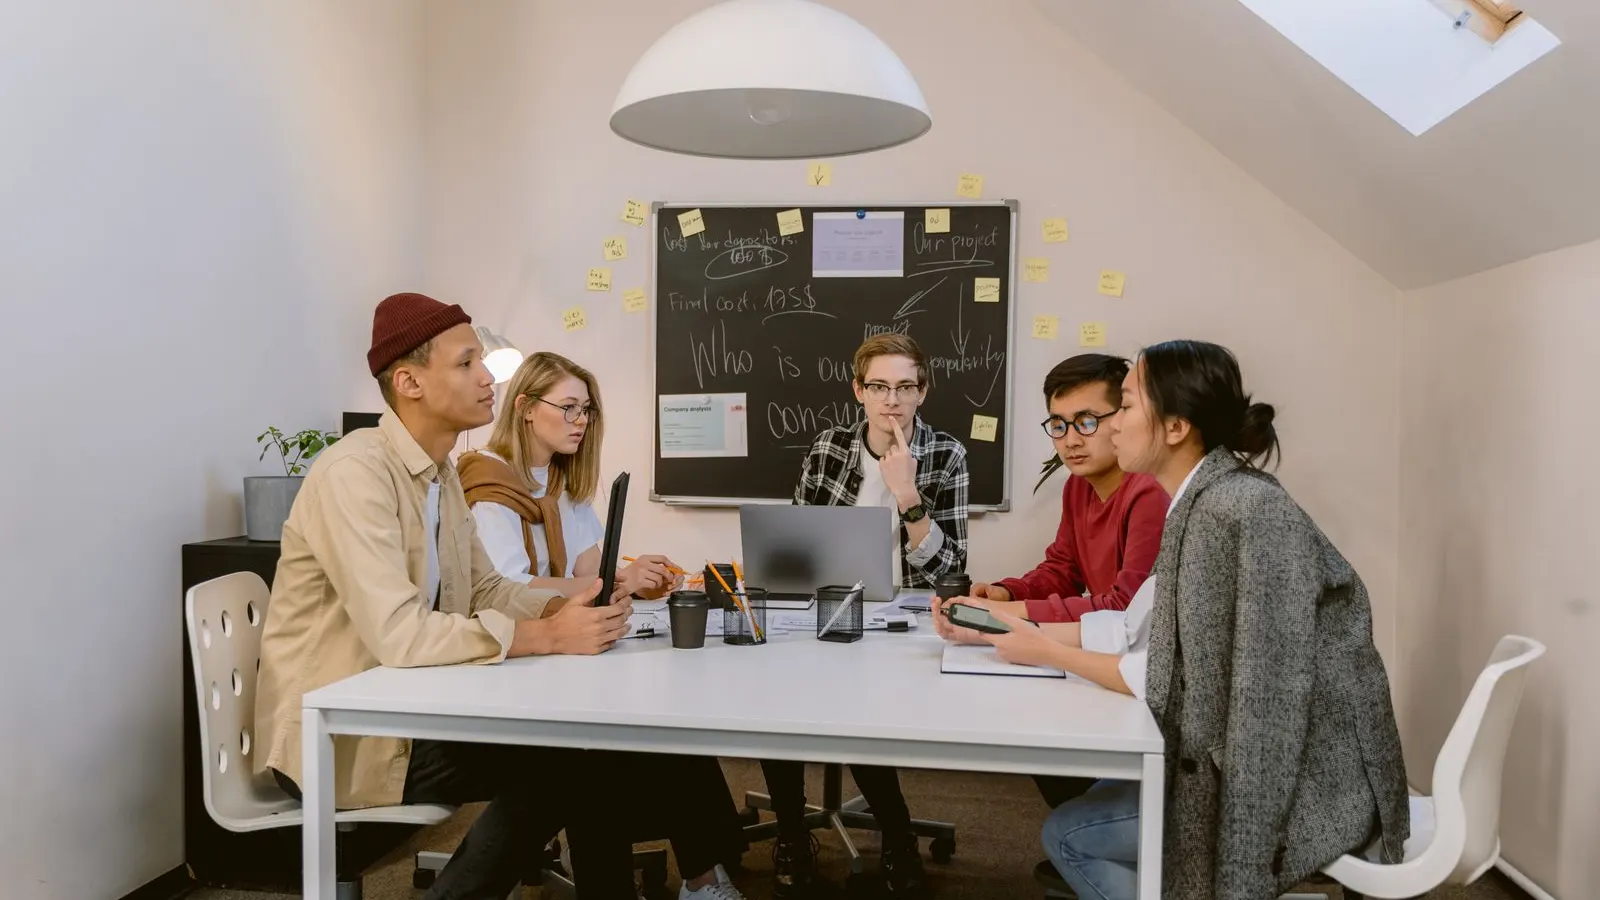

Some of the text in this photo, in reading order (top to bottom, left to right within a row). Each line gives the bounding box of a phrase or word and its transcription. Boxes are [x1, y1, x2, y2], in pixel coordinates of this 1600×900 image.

[913, 221, 945, 255] Our
[952, 223, 999, 264] project
[668, 286, 709, 314] Final
[688, 318, 753, 390] Who
[772, 345, 801, 382] is
[929, 333, 1006, 407] popularity
